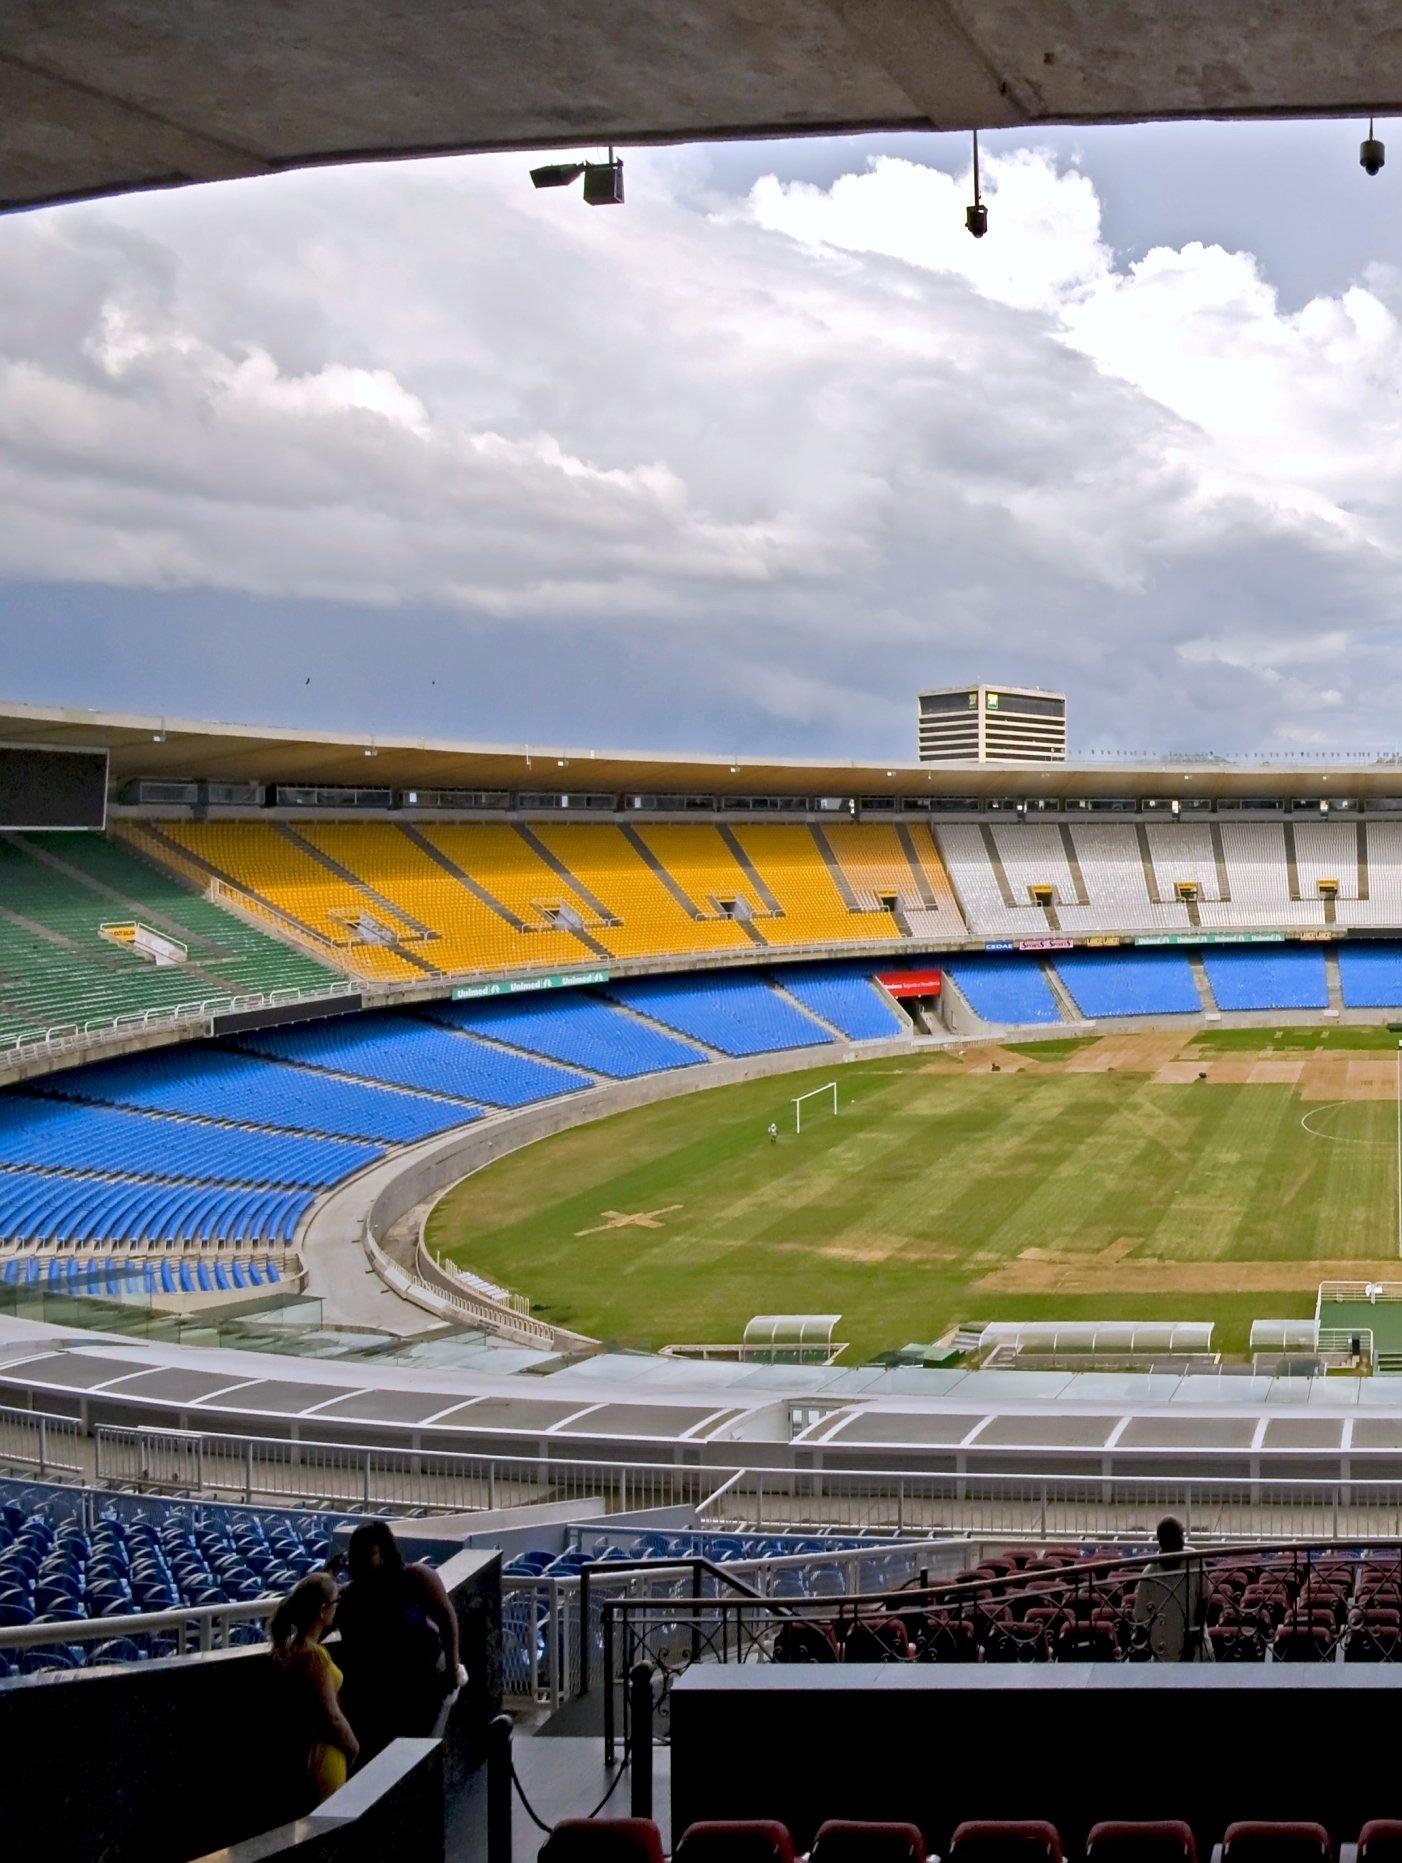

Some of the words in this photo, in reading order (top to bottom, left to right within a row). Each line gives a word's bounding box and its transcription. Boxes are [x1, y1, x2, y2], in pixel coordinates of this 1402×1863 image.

[457, 986, 489, 998] Unimed
[510, 980, 541, 992] Unimed
[562, 974, 592, 985] Unimed
